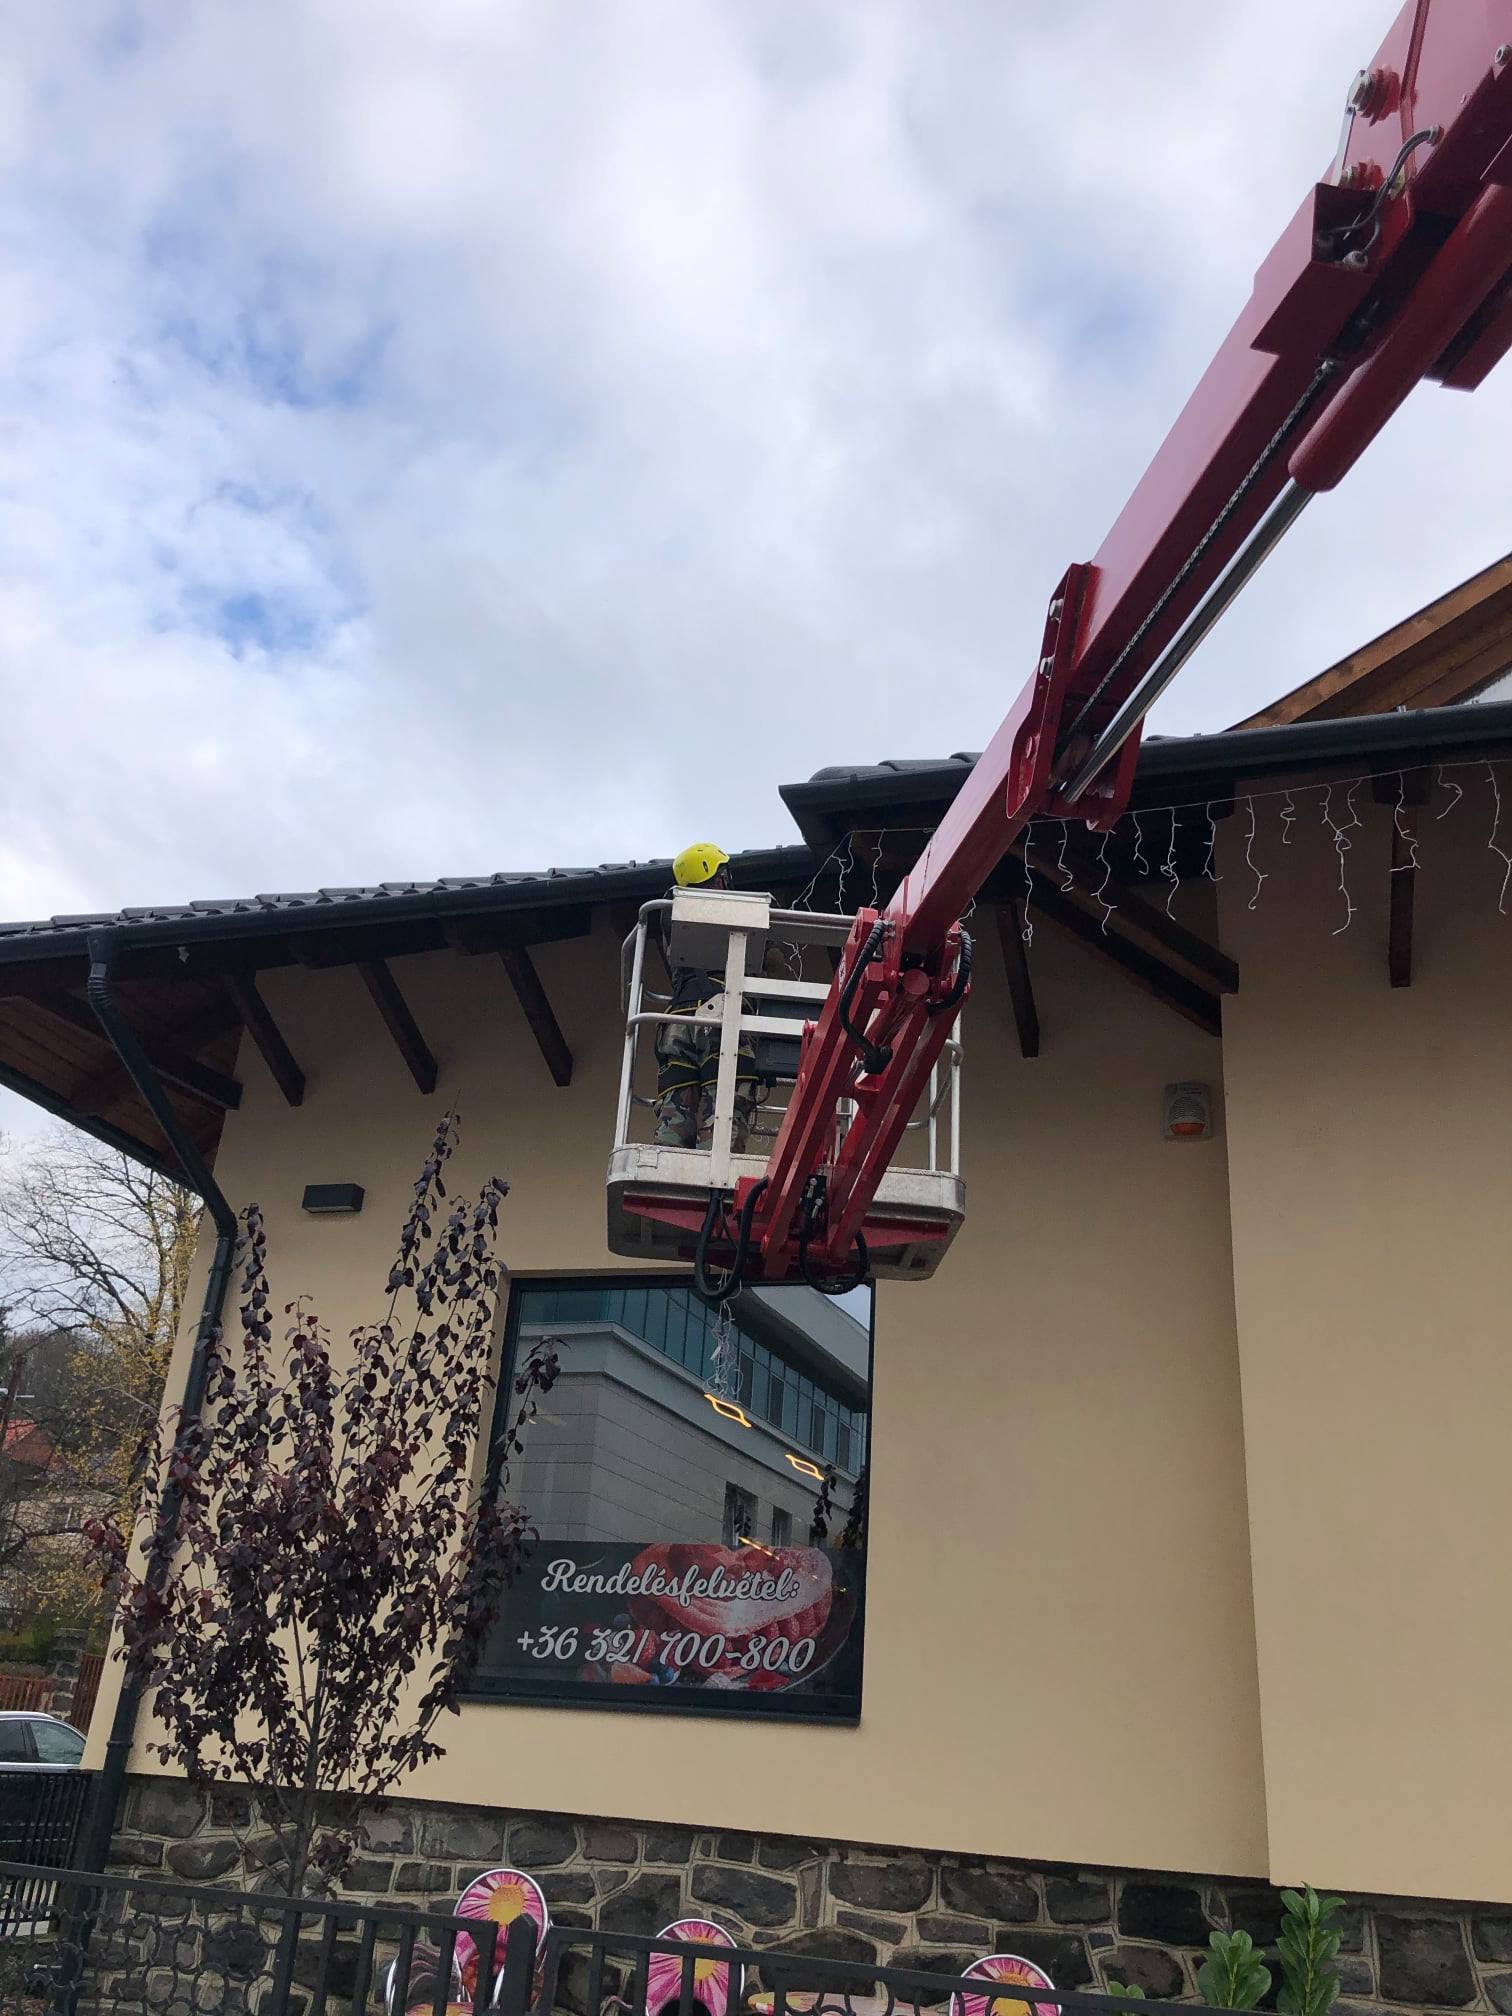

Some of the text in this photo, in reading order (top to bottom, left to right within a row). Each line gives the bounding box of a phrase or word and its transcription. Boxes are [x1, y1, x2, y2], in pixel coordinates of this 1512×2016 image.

[541, 1559, 800, 1607] Rendelésfelvétel:
[517, 1626, 816, 1672] +36 32/ 700-800
